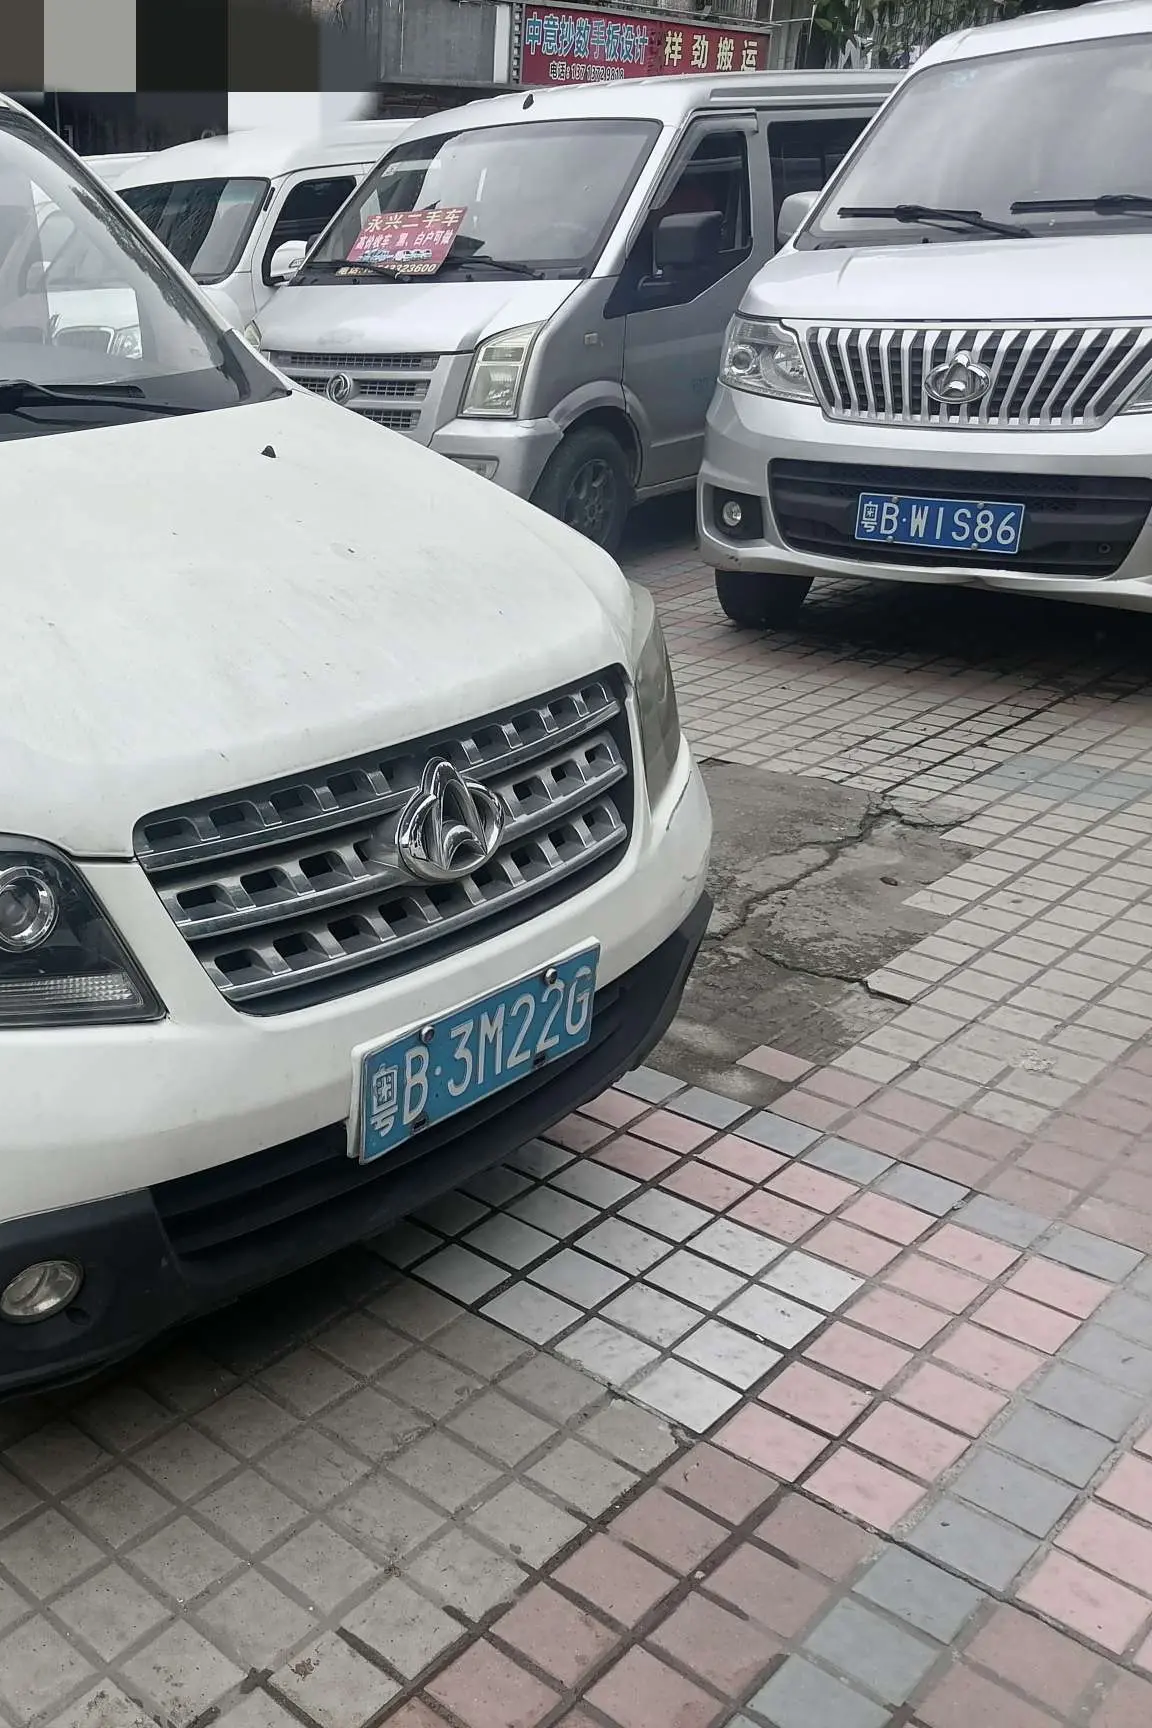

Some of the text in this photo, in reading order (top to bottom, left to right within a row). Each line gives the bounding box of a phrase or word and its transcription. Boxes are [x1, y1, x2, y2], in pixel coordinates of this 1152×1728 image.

[525, 11, 649, 65] 中意抄数手板设计
[663, 29, 759, 73] 祥劲搬运
[365, 208, 464, 233] 永兴二手车
